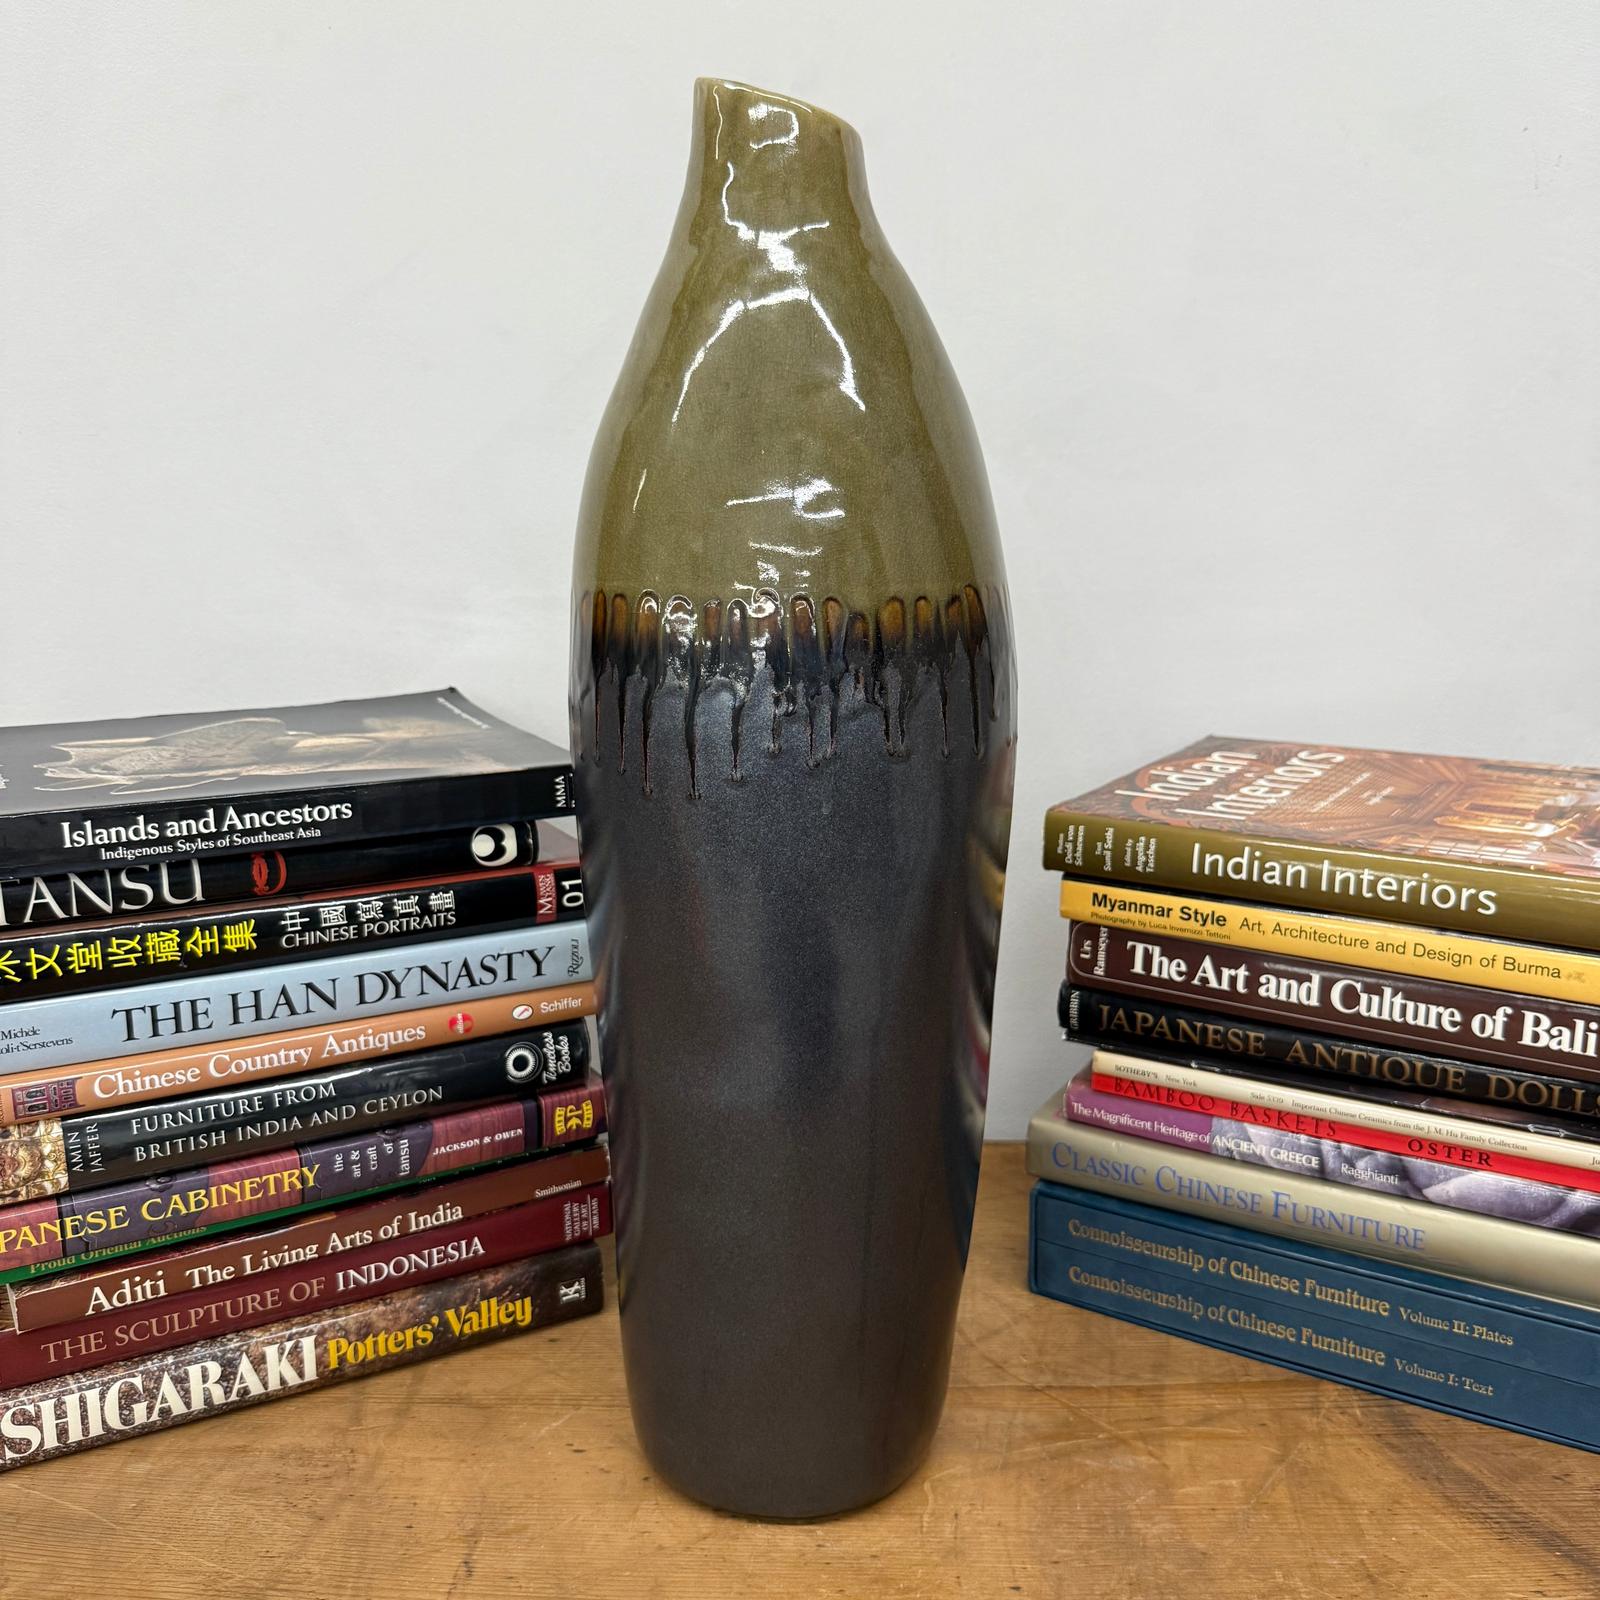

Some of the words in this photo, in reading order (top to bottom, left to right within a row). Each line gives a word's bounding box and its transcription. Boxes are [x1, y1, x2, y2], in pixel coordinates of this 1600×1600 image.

[555, 775, 567, 808] MMA
[1114, 750, 1258, 801] Indian
[1173, 750, 1345, 820] Interiors
[60, 815, 160, 849] Islands
[166, 808, 217, 838] and
[221, 802, 353, 832] Ancestors
[101, 844, 174, 861] Indigenous
[177, 838, 215, 854] Styles
[217, 834, 232, 847] of
[233, 830, 296, 846] Southeast
[297, 827, 322, 840] Asia
[1067, 824, 1075, 841] von
[1146, 837, 1157, 873] Taschen
[1191, 842, 1307, 889] Indian
[1319, 860, 1498, 916] Interiors
[0, 858, 205, 926] TANSU
[561, 879, 584, 908] 01
[281, 924, 358, 949] CHINESE
[363, 911, 456, 937] PORTRAITS
[1090, 912, 1136, 927] Photography
[1138, 919, 1146, 928] by
[1149, 921, 1168, 931] Luca
[1091, 892, 1173, 918] Myanmar
[1179, 906, 1228, 928] Style
[1239, 917, 1265, 935] Art,
[1272, 922, 1370, 949] Architecture
[1375, 940, 1406, 956] and
[1413, 943, 1472, 968] Design
[1479, 953, 1497, 969] of
[1503, 956, 1561, 979] Burma
[1080, 938, 1092, 959] Urs
[110, 997, 214, 1043] THE
[228, 977, 341, 1026] HAN
[354, 945, 556, 1006] DYNASTY
[540, 997, 583, 1014] Schiffer
[1068, 990, 1081, 1031] GRIBBIN
[1126, 940, 1188, 982] The
[1191, 954, 1249, 995] Art
[1257, 972, 1322, 1008] and
[1330, 979, 1462, 1033] Culture
[1471, 1006, 1513, 1041] of
[1517, 1009, 1599, 1058] Bali
[93, 1066, 201, 1099] Chinese
[208, 1045, 313, 1079] Country
[321, 1025, 426, 1058] Antiques
[542, 1031, 558, 1085] Timeless
[556, 1034, 572, 1074] Books
[1098, 1003, 1266, 1057] JAPANESE
[1286, 1040, 1467, 1094] ANTIQUE
[1487, 1074, 1600, 1117] DOLL
[132, 1097, 264, 1136] FURNITURE
[273, 1083, 336, 1109] FROM
[135, 1131, 227, 1162] BRITISH
[237, 1115, 303, 1141] INDIA
[310, 1104, 356, 1127] AND
[364, 1085, 443, 1114] CEYLON
[1114, 1077, 1216, 1111] BAMBOO
[1229, 1101, 1336, 1137] BASKETS
[1407, 1138, 1494, 1168] OSTER
[1291, 1100, 1328, 1114] Important
[1328, 1107, 1357, 1120] Chinese
[1358, 1112, 1392, 1125] Ceramics
[1393, 1119, 1411, 1130] from
[1412, 1123, 1425, 1132] the
[1446, 1128, 1459, 1138] Hu
[1460, 1130, 1487, 1146] Family
[1488, 1136, 1528, 1151] Collection
[67, 1131, 84, 1172] AMIN
[85, 1122, 105, 1173] JAFFER
[334, 1153, 344, 1172] the
[350, 1150, 360, 1161] &
[367, 1145, 378, 1170] craft
[383, 1142, 393, 1154] of
[399, 1138, 410, 1176] tansu
[432, 1138, 481, 1156] JACKSON
[494, 1128, 524, 1141] OWEN
[1072, 1102, 1091, 1118] The
[1092, 1107, 1152, 1131] Magnificent
[1153, 1119, 1199, 1143] Heritage
[1199, 1132, 1212, 1144] of
[1212, 1135, 1269, 1157] ANCIENT
[1270, 1147, 1320, 1169] GREECE
[1341, 1162, 1399, 1186] Ragghianti
[352, 1163, 361, 1178] art
[535, 1179, 582, 1198] Smithsonian
[1051, 1141, 1146, 1186] CLASSIC
[1155, 1165, 1262, 1215] CHINESE
[1271, 1190, 1425, 1251] FURNITURE
[0, 1205, 131, 1254] PANESE
[141, 1164, 320, 1221] CABINETRY
[85, 1270, 169, 1316] Aditi
[185, 1263, 236, 1289] The
[242, 1244, 319, 1276] Living
[325, 1229, 374, 1255] Arts
[379, 1215, 402, 1240] of
[408, 1202, 464, 1233] India
[1068, 1218, 1204, 1272] Connoisseurship
[1207, 1257, 1228, 1275] of
[1229, 1260, 1300, 1295] Chinese
[1304, 1278, 1391, 1317] Furniture
[1399, 1307, 1450, 1331] Volume
[1452, 1319, 1470, 1336] II:
[1471, 1324, 1515, 1346] Plates
[40, 1331, 107, 1364] THE
[114, 1288, 282, 1347] SCULPTURE
[289, 1277, 326, 1303] OF
[336, 1236, 486, 1293] INDONESIA
[1068, 1265, 1204, 1320] Connoisseurship
[1207, 1305, 1227, 1323] of
[1227, 1308, 1297, 1342] Chinese
[1301, 1326, 1387, 1366] Furniture
[1394, 1358, 1445, 1382] Volume
[1447, 1373, 1459, 1387] I:
[1461, 1376, 1495, 1397] Text
[0, 1334, 320, 1460] SHIGARAKI
[444, 1296, 533, 1337] Valley
